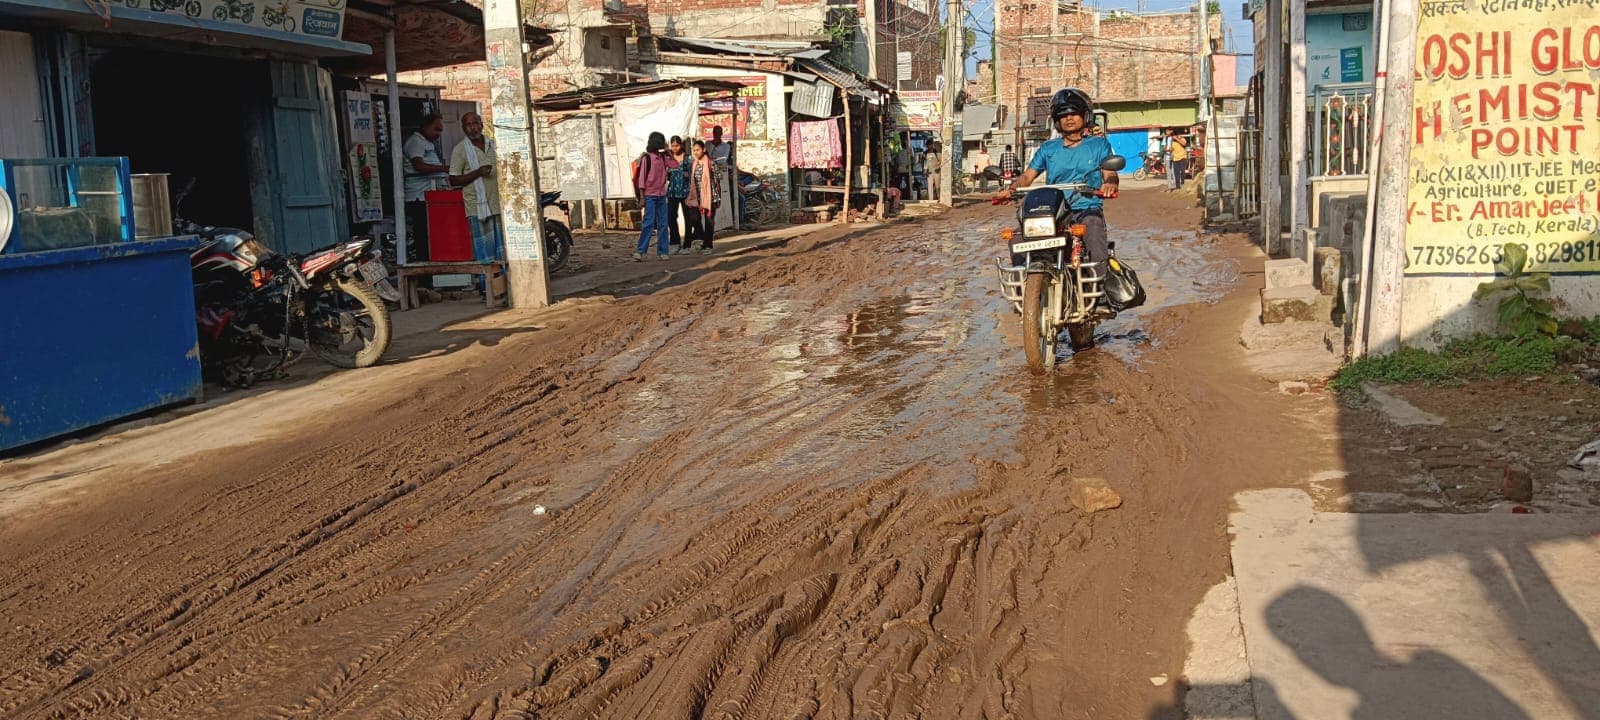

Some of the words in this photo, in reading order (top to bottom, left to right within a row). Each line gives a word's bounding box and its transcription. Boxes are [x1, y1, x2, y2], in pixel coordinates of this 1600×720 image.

[1415, 31, 1512, 82] OSHI
[1415, 81, 1600, 145] HEMIST
[1471, 125, 1586, 160] POINT
[1510, 161, 1563, 179] IIT-JEE
[1424, 183, 1528, 202] Agriculture,
[1534, 179, 1578, 195] CUET
[1584, 177, 1600, 192] e
[1431, 202, 1464, 223] Er.
[1469, 191, 1587, 221] Amarjeet
